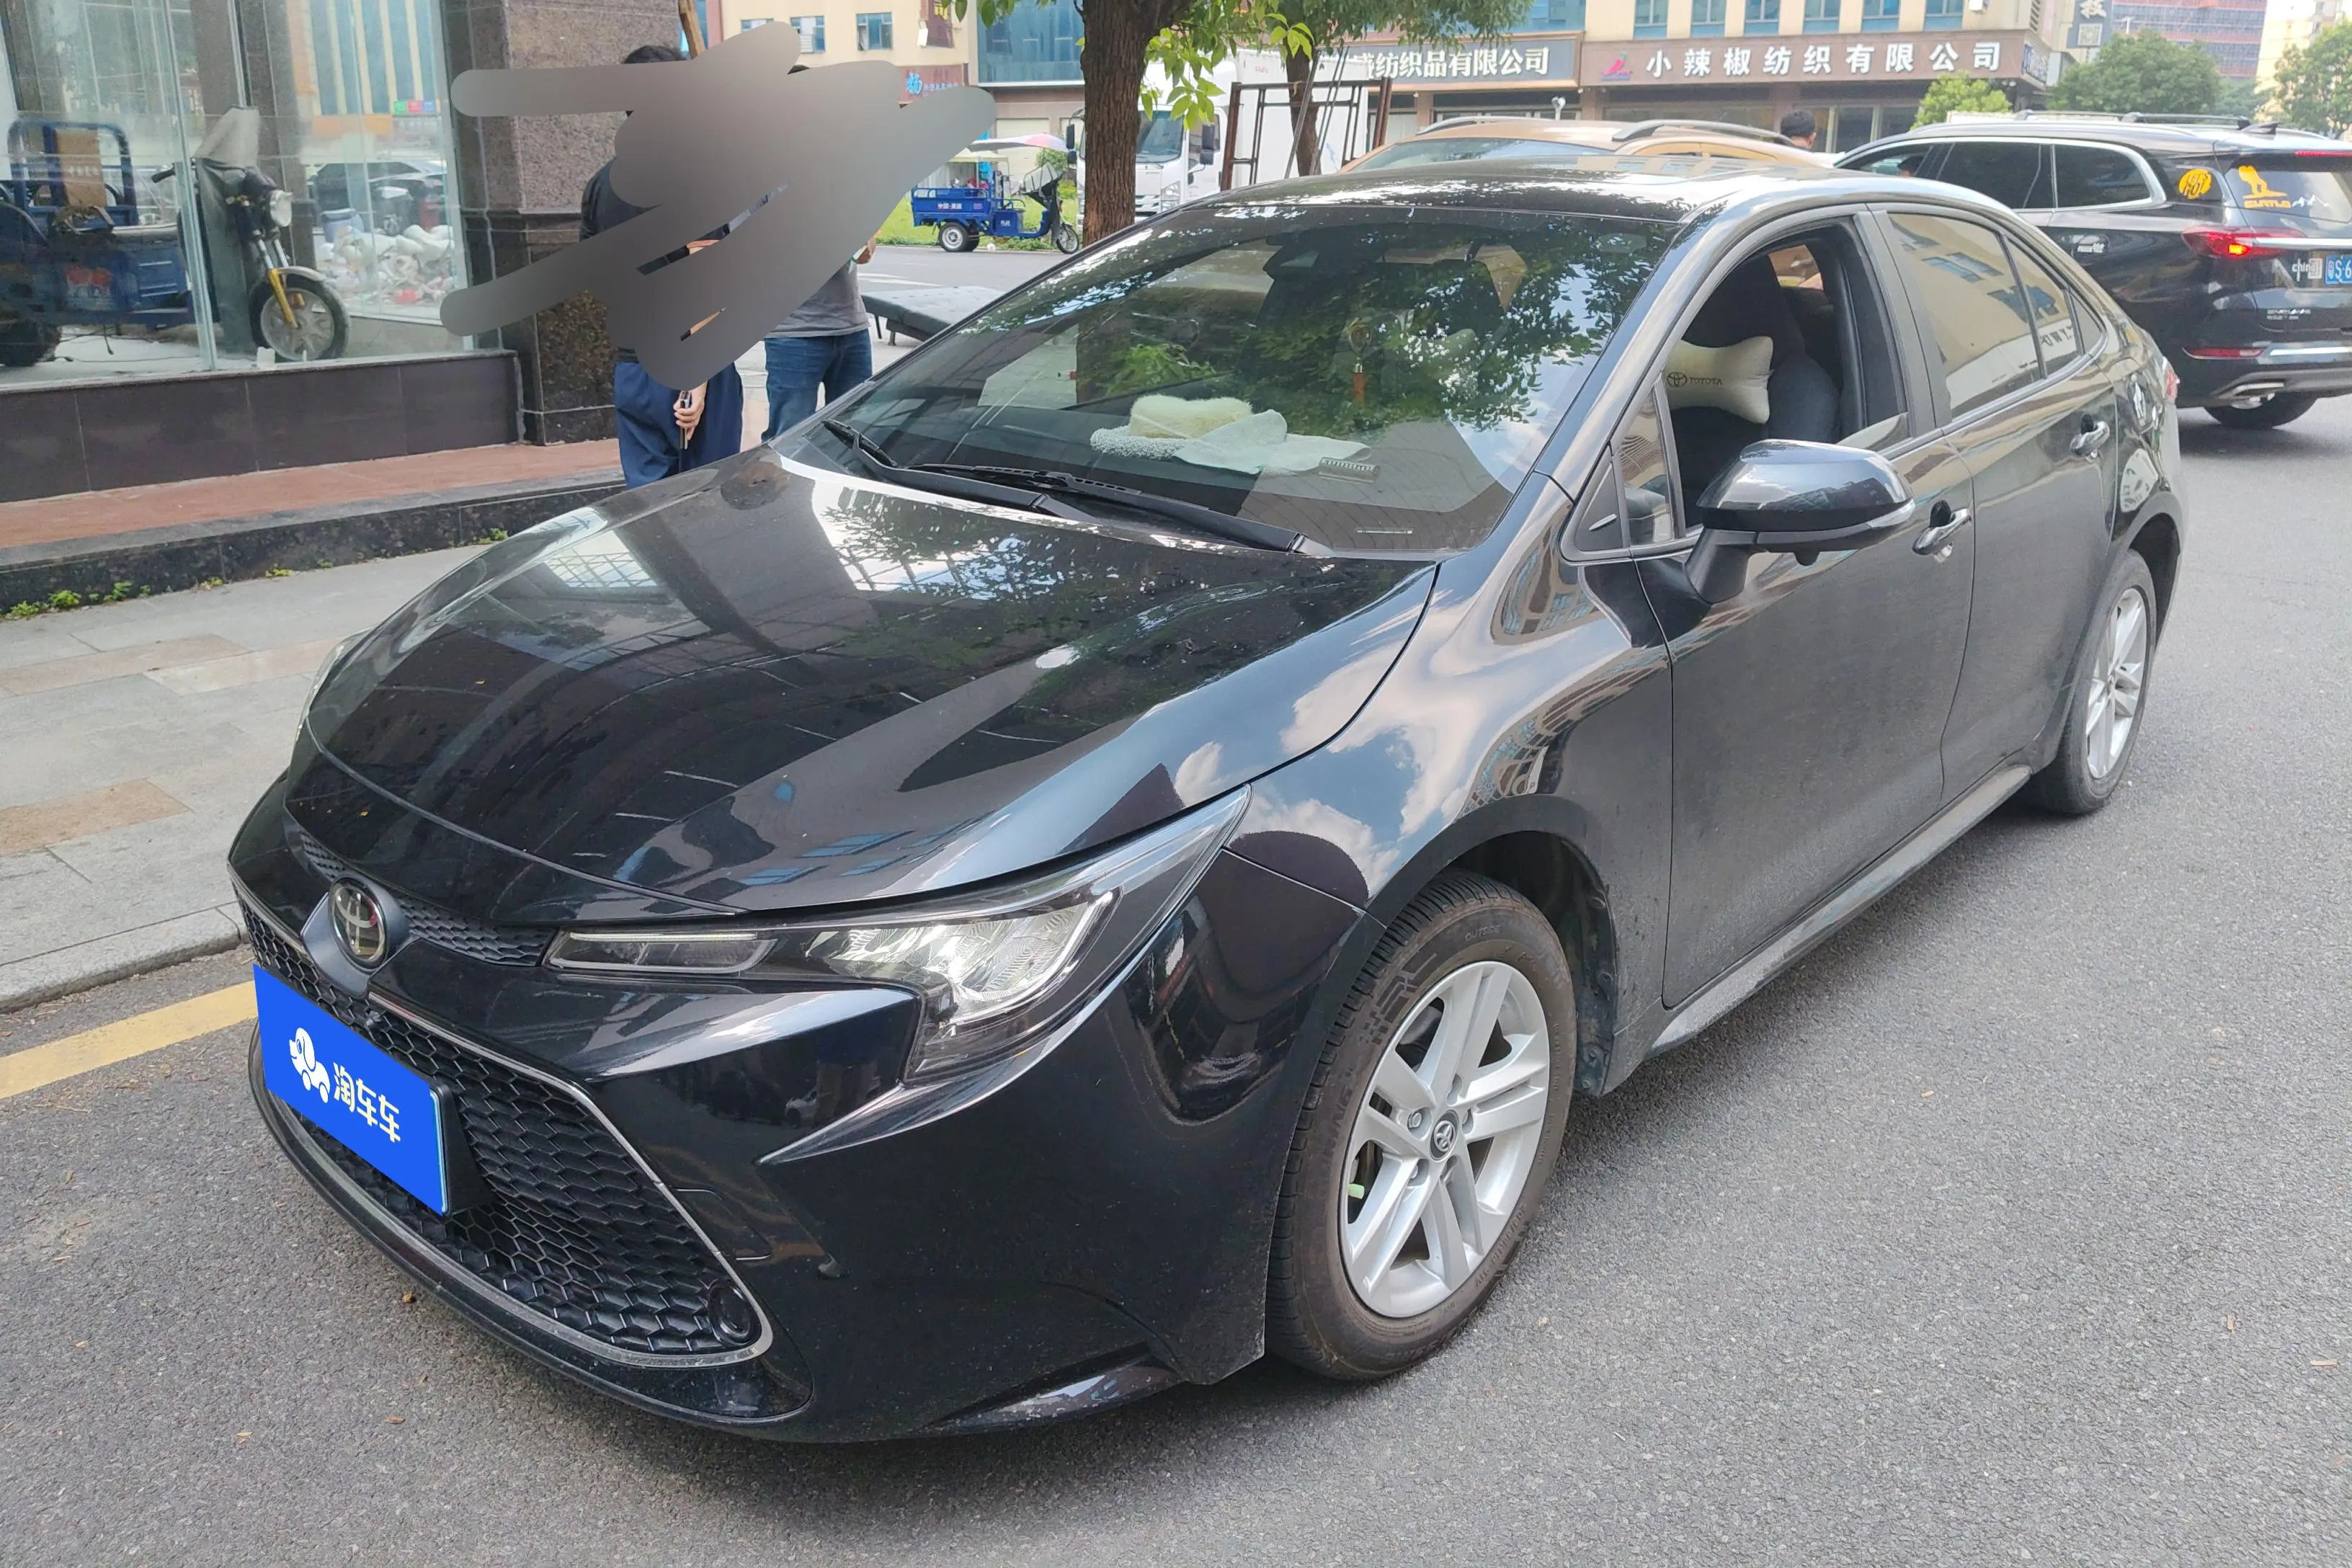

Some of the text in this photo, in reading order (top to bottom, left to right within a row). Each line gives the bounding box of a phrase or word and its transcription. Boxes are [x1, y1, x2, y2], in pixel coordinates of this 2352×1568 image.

[1645, 41, 2001, 78] 小辣椒纺织有限公司
[1689, 376, 1722, 386] TOYOTA
